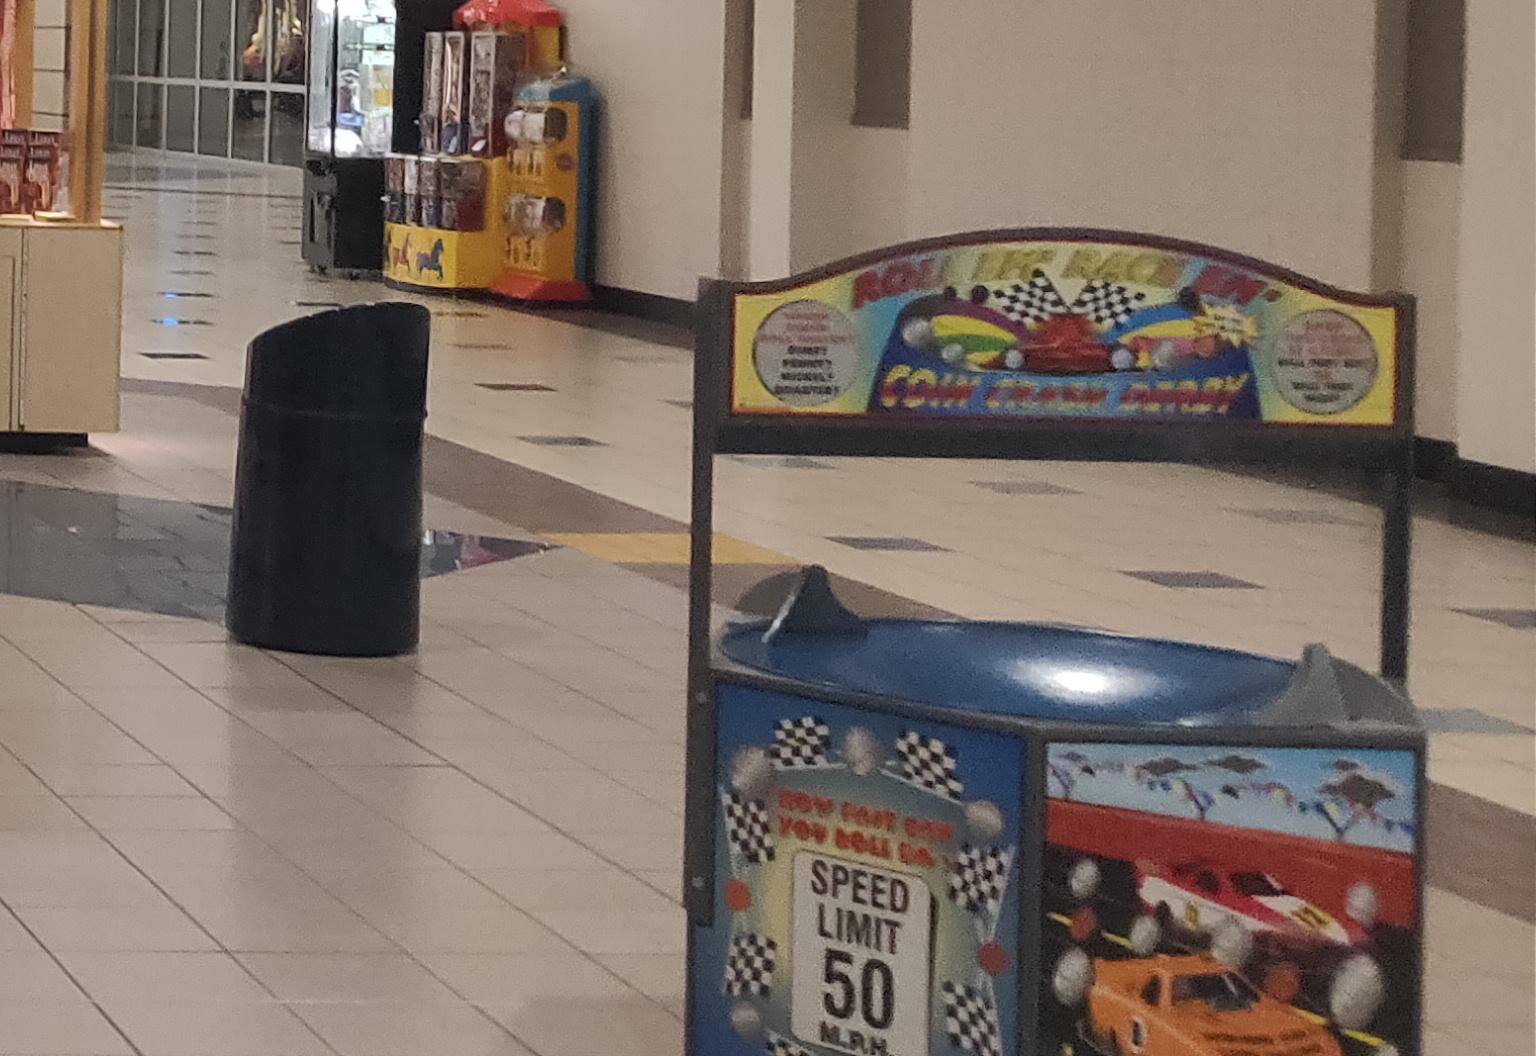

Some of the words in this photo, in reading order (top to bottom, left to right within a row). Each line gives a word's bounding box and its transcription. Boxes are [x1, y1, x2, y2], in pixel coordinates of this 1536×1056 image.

[779, 816, 826, 843] YOU
[811, 859, 910, 913] SPEED
[818, 902, 903, 955] LIMIT
[822, 948, 894, 1029] 50
